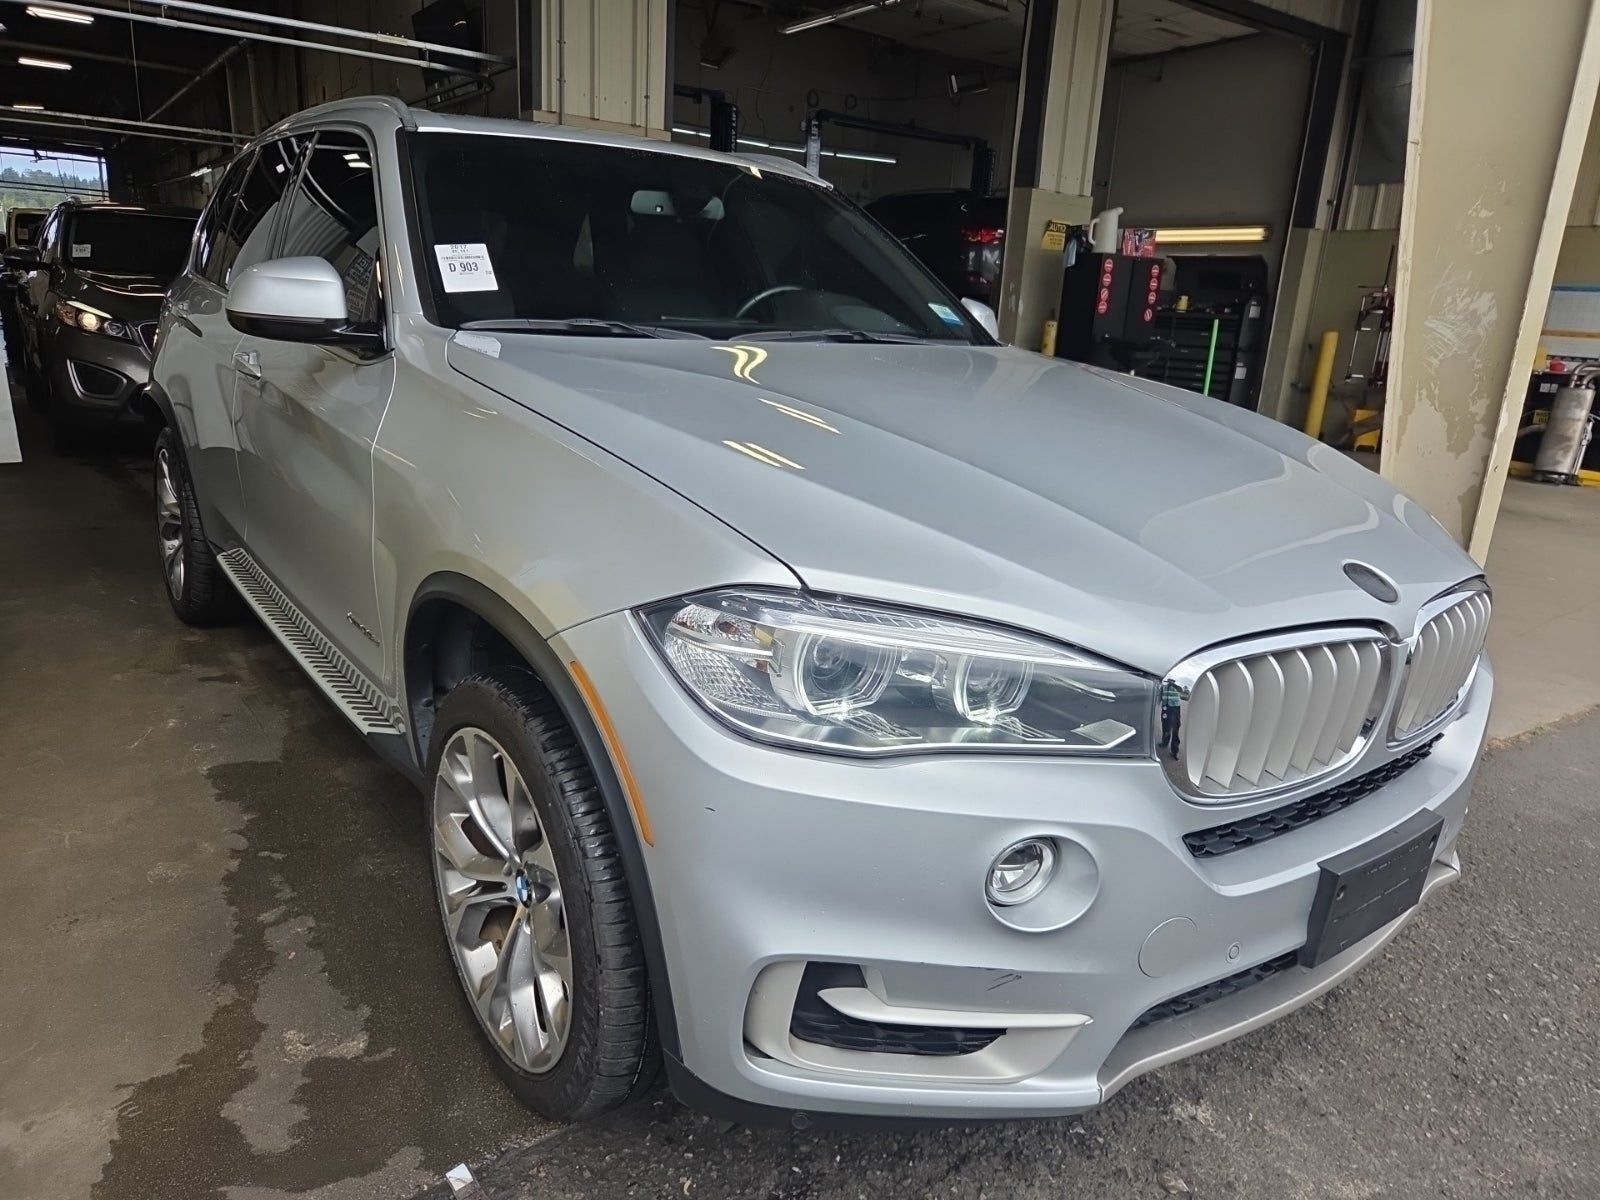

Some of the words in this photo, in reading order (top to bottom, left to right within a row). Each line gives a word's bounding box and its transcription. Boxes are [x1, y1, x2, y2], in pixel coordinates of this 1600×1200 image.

[811, 119, 819, 140] LIFT
[448, 262, 457, 272] D
[460, 261, 479, 272] 903
